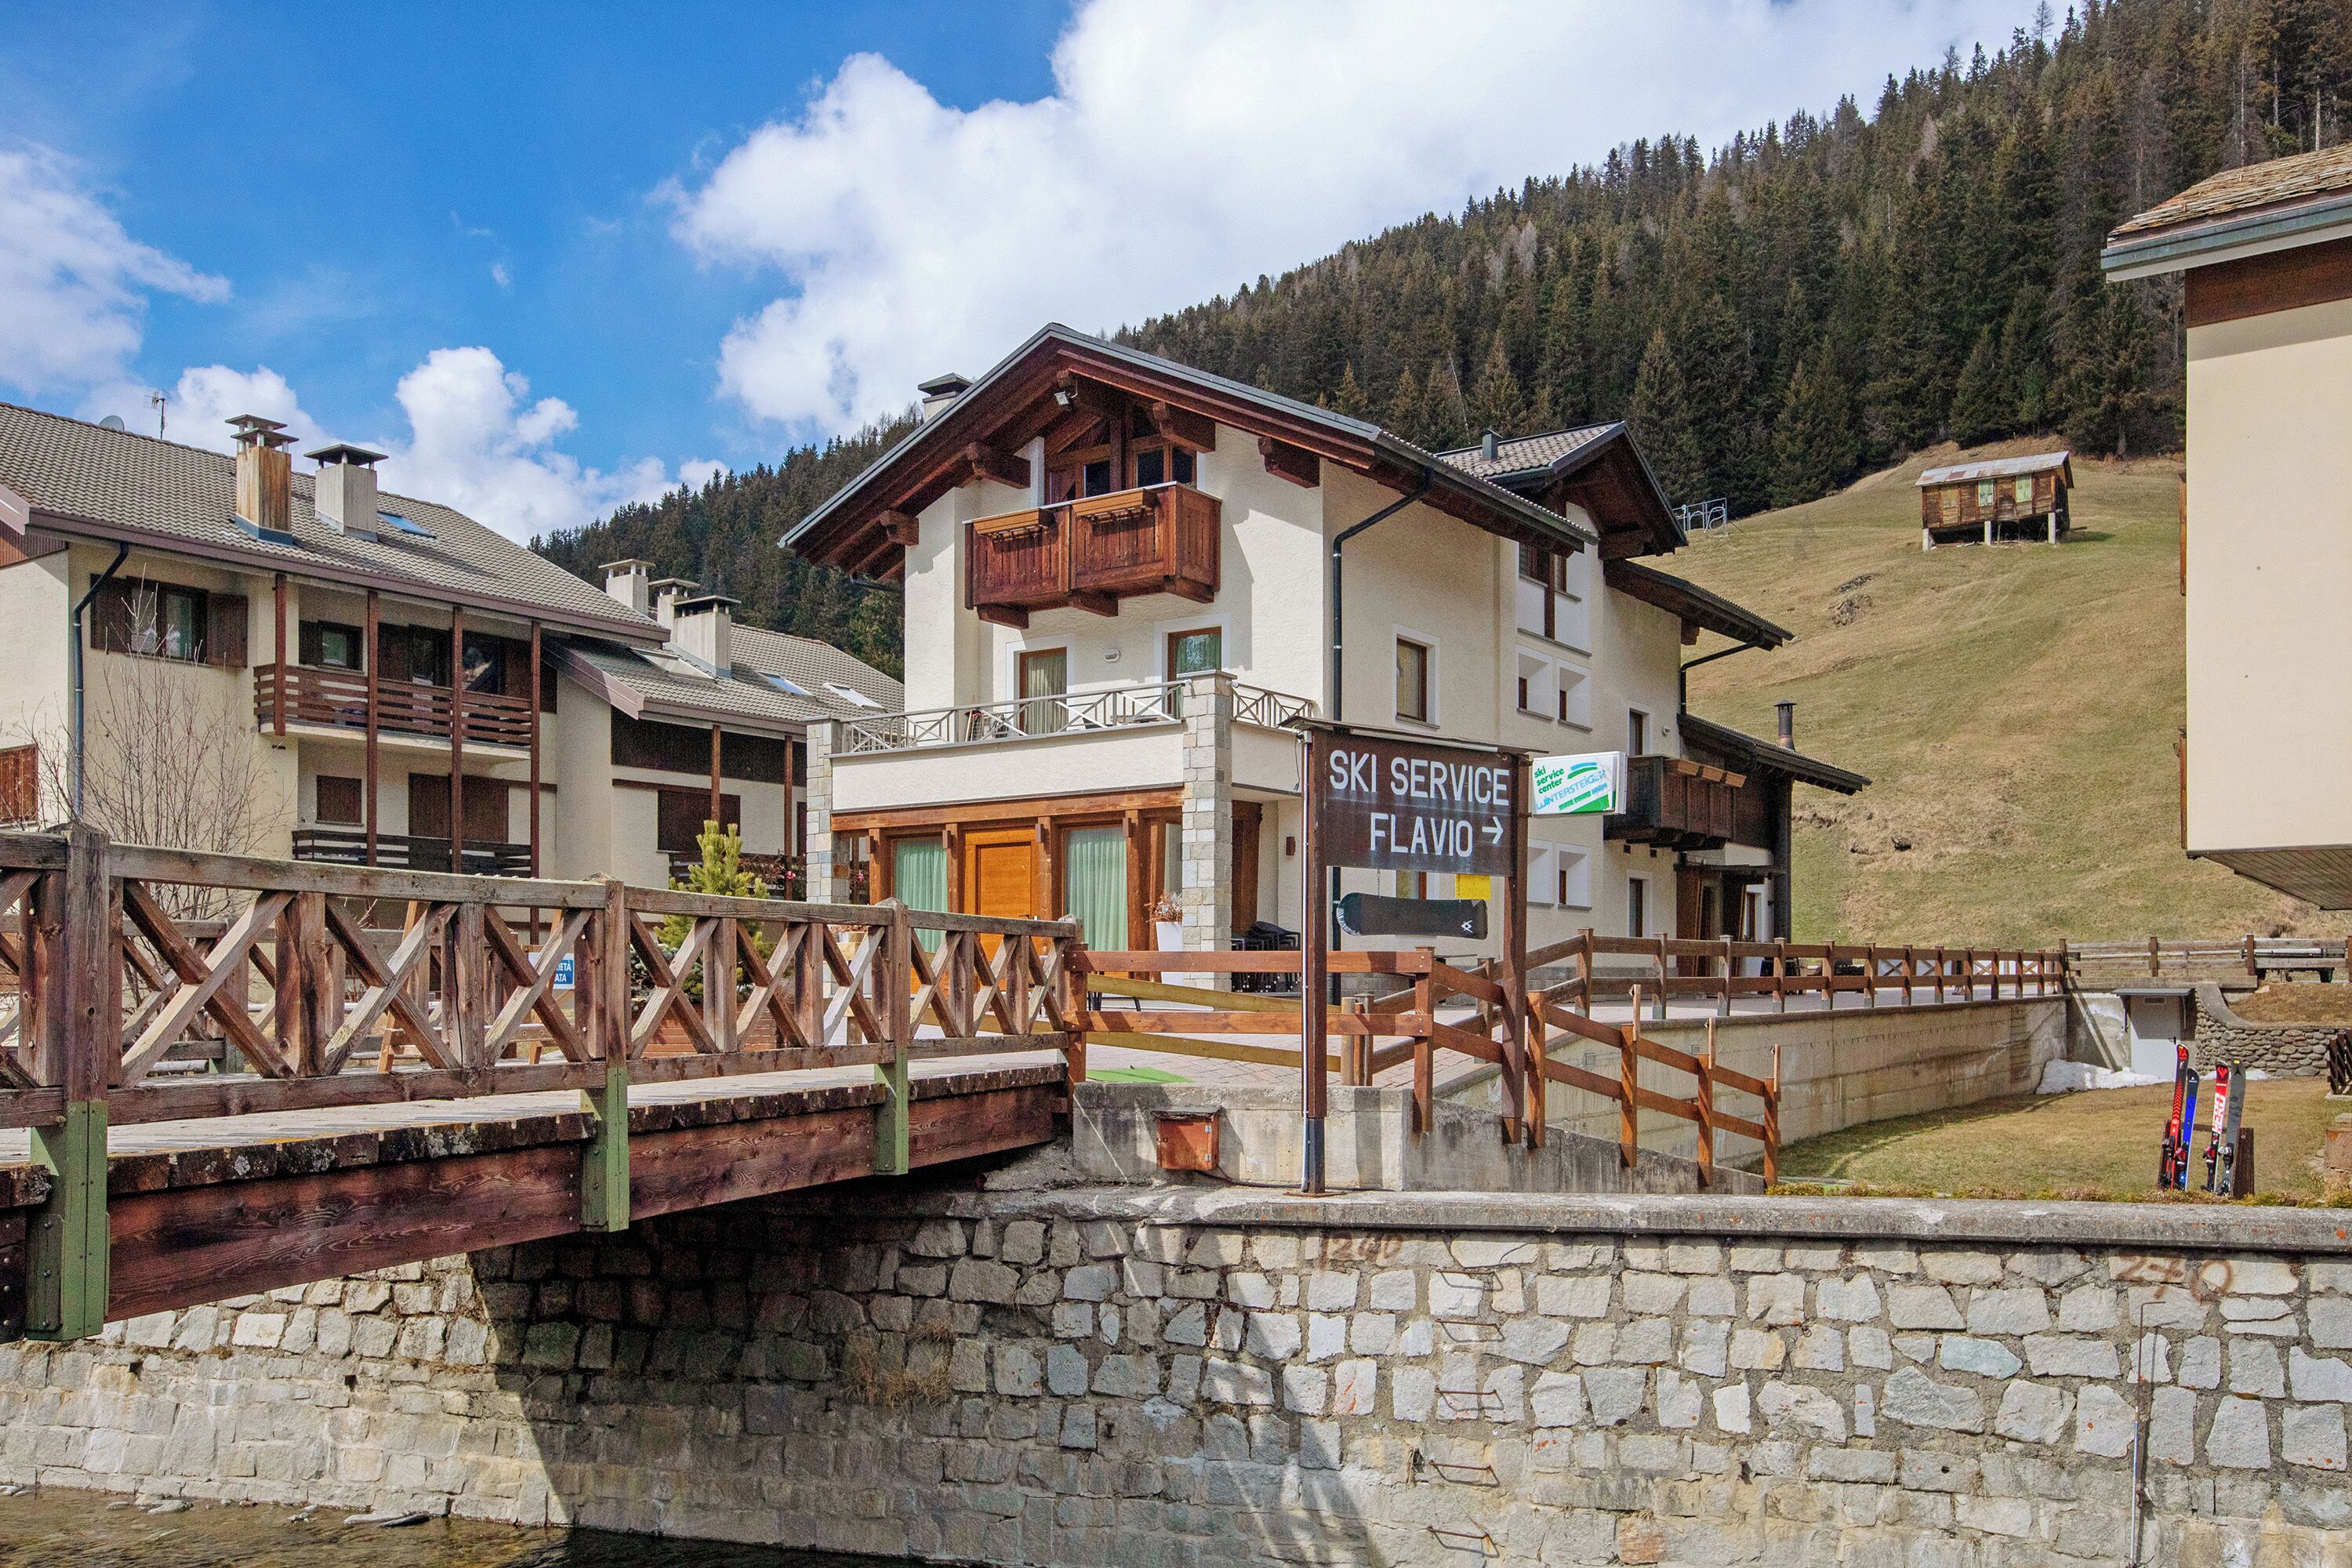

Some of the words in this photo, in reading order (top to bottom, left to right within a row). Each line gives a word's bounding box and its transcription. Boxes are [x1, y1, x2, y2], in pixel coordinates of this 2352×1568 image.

[1330, 750, 1377, 793] SKI
[1390, 757, 1510, 806] SERVICE
[1534, 766, 1546, 779] ski
[1537, 768, 1565, 786] service
[1538, 778, 1563, 794] center
[1370, 812, 1473, 858] FLAVIO
[554, 974, 567, 982] ATA
